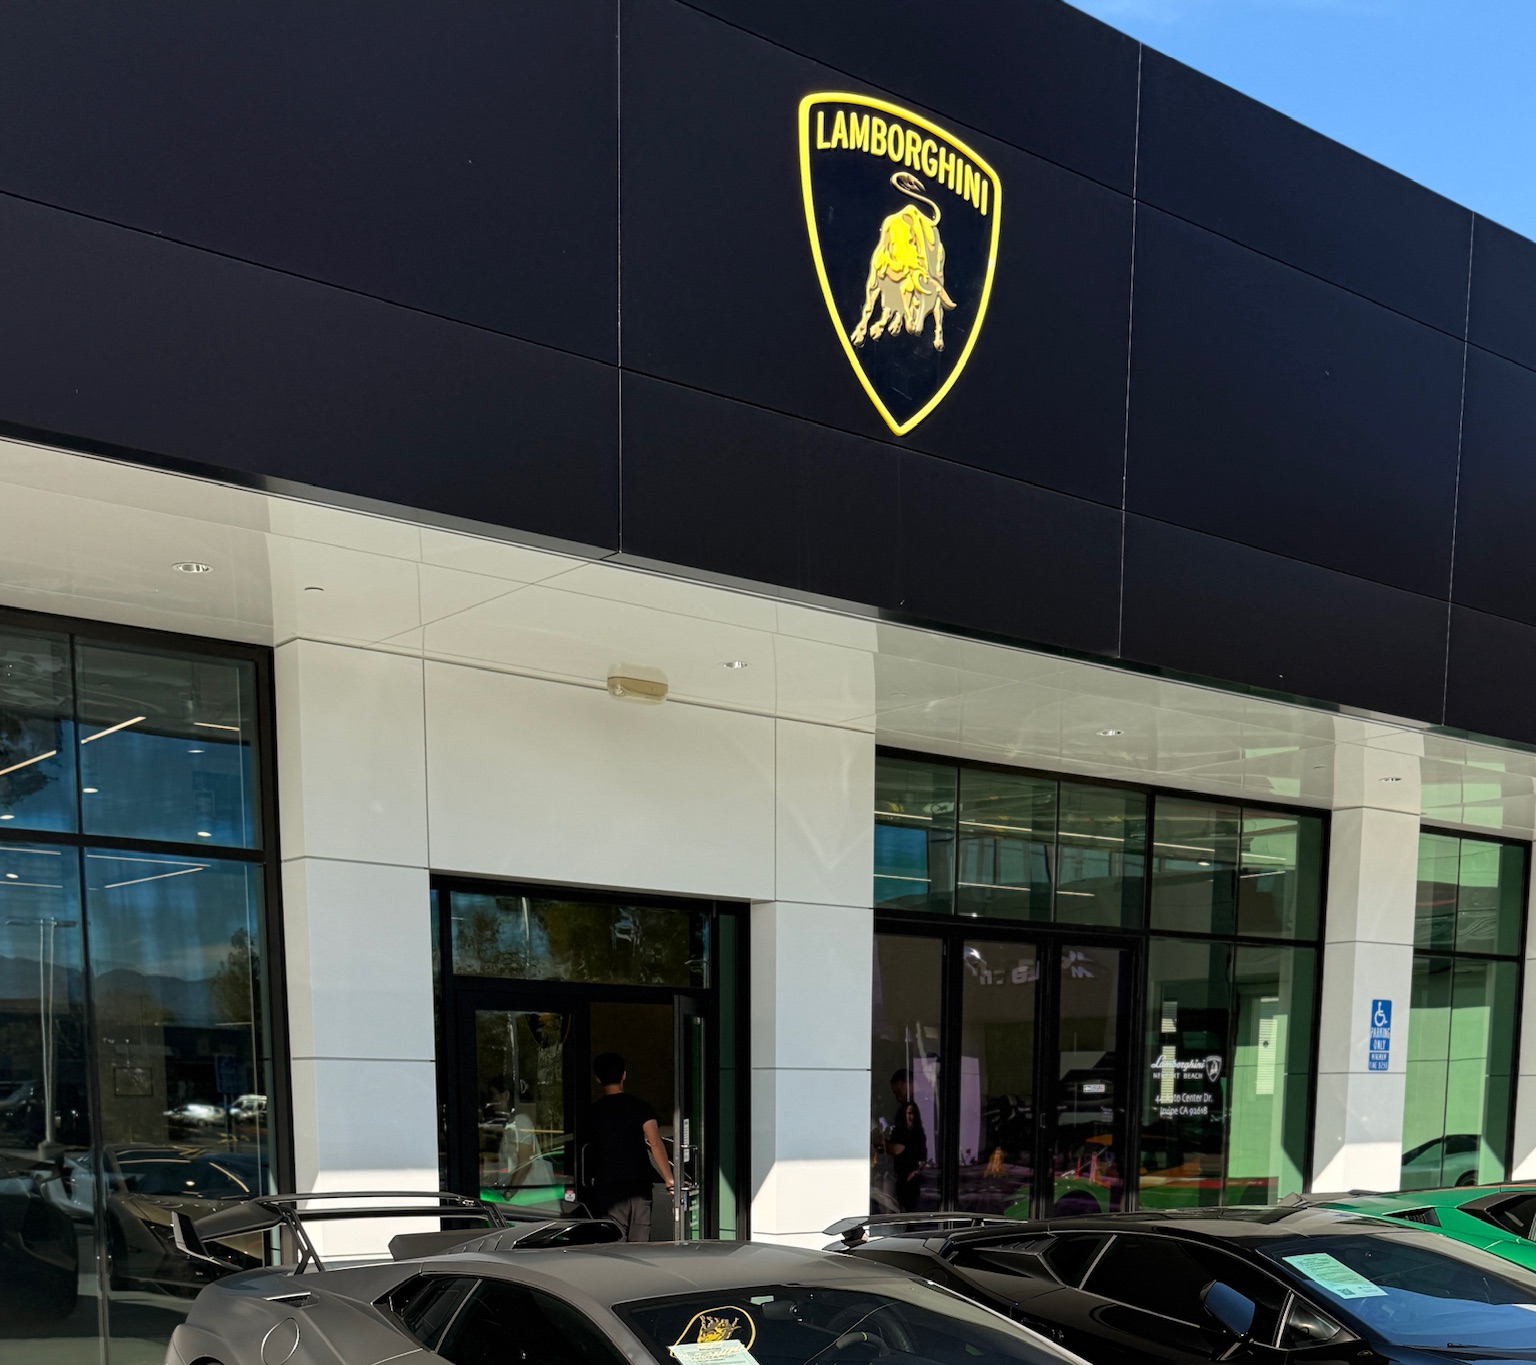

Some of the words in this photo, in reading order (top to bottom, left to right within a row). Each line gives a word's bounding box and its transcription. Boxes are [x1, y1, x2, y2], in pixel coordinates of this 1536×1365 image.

[816, 110, 989, 216] LAMBORGHINI
[1371, 1027, 1391, 1038] PARKING
[1373, 1039, 1386, 1050] ONLY
[1150, 1055, 1206, 1072] Lamborghini
[1182, 1093, 1202, 1103] Center
[1203, 1092, 1213, 1103] Dr.
[1179, 1106, 1188, 1115] CA
[1189, 1106, 1208, 1116] 92618
